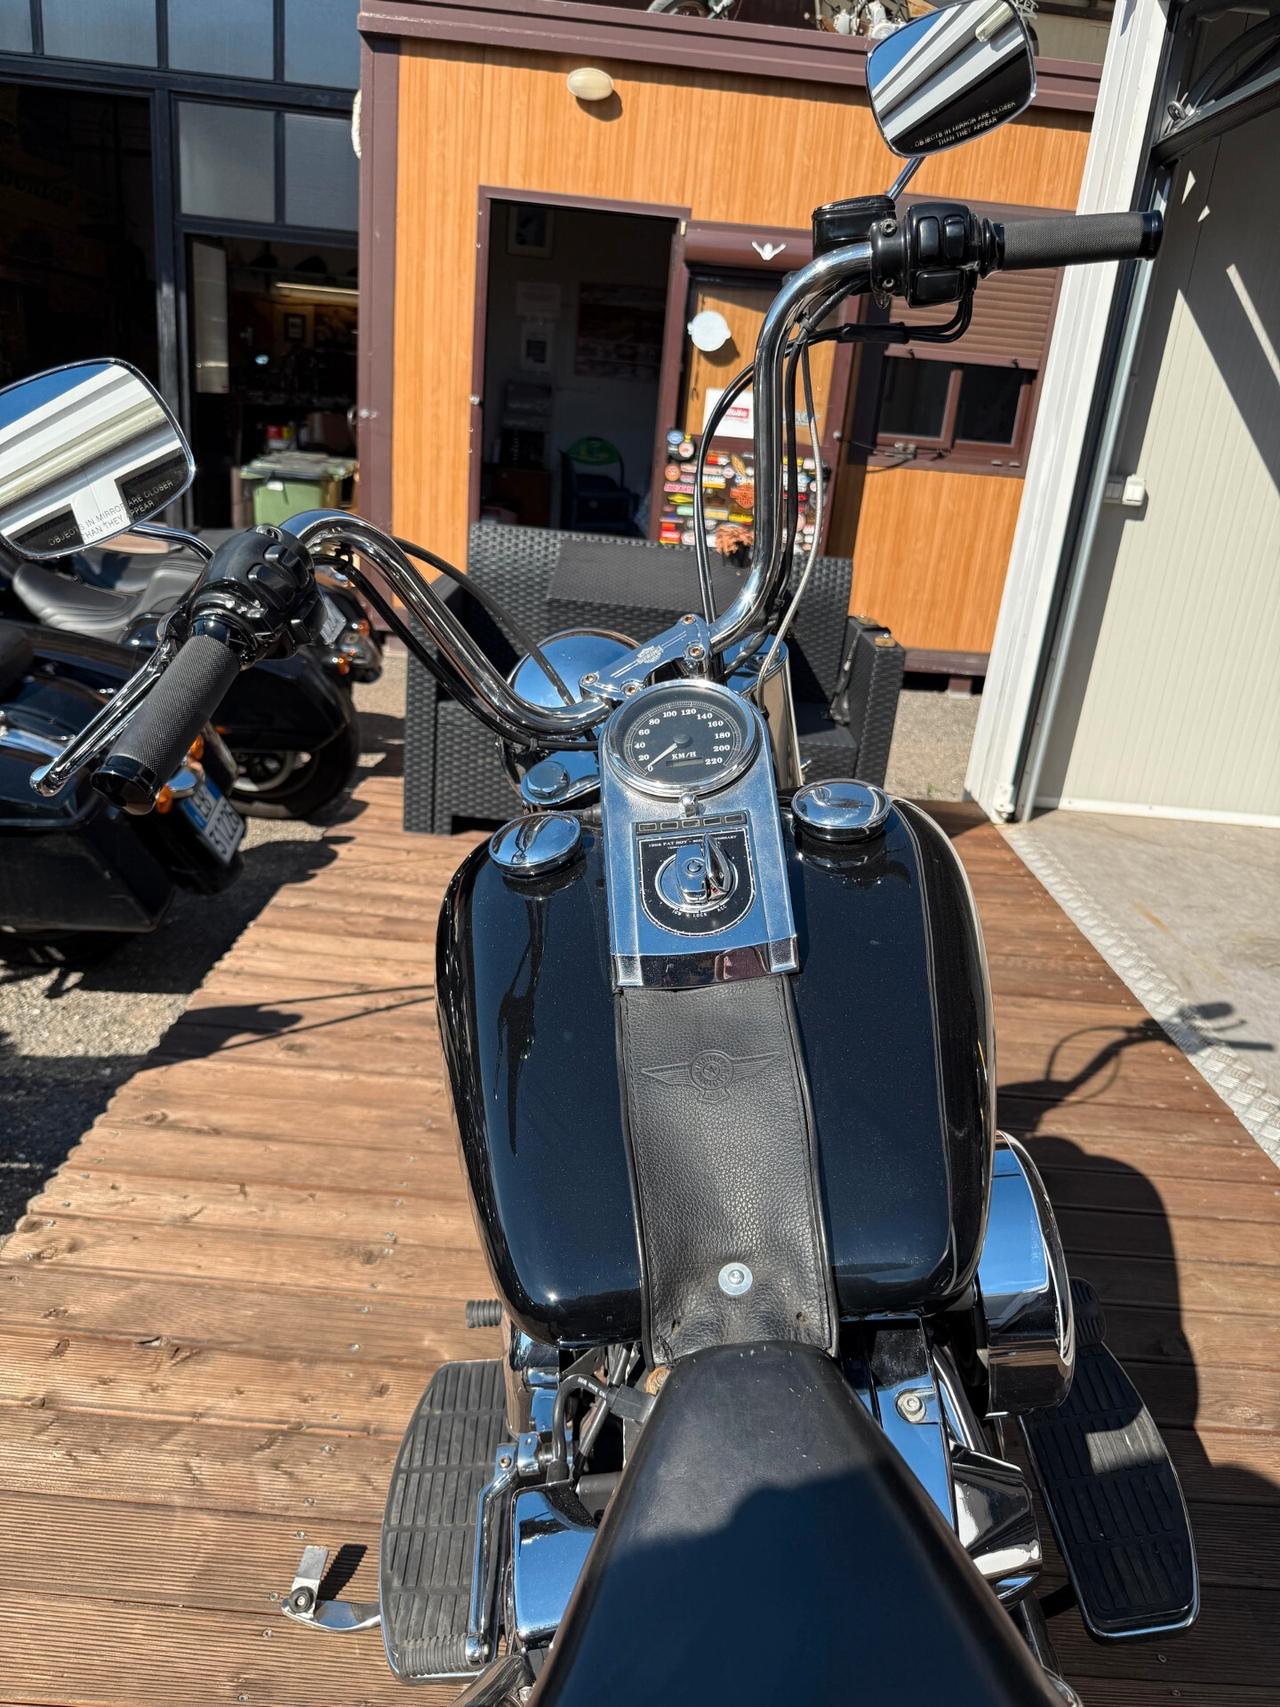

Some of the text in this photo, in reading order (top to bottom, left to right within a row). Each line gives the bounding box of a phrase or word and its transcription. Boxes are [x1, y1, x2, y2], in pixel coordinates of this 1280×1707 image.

[85, 517, 95, 528] IN
[127, 494, 143, 507] ARE
[145, 479, 174, 498] CLOSER
[104, 514, 124, 529] THEY
[662, 710, 678, 718] 100
[681, 708, 697, 716] 120
[696, 712, 713, 720] 140
[707, 720, 724, 728] 160
[714, 732, 731, 740] 180
[712, 744, 731, 752] 200
[671, 751, 697, 760] KM/H
[705, 757, 723, 765] 220
